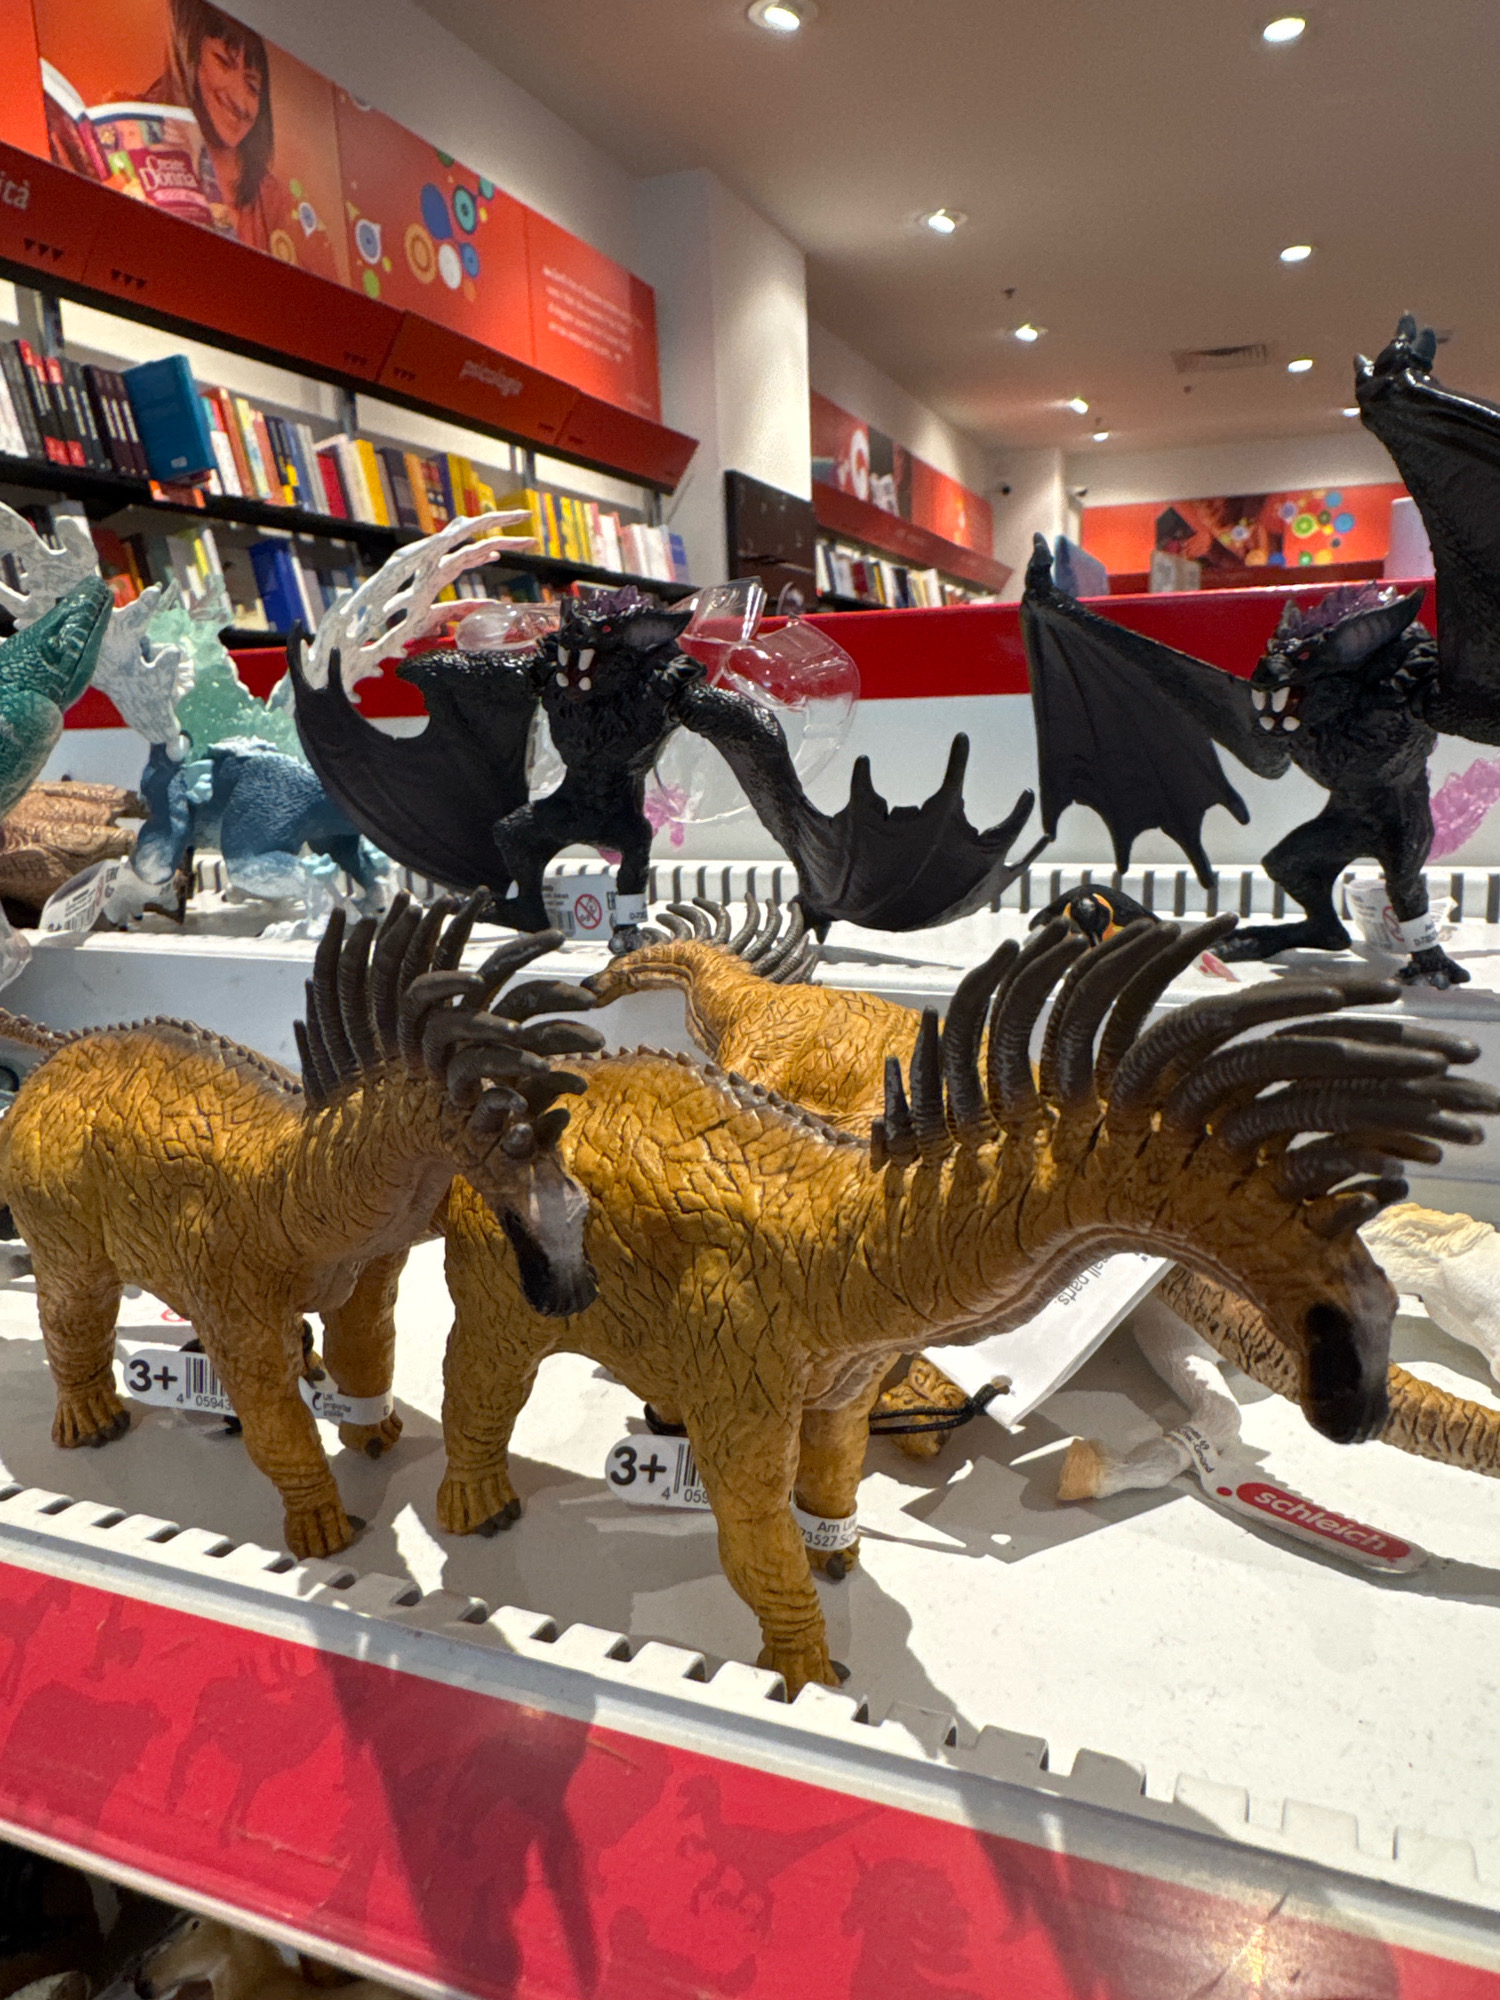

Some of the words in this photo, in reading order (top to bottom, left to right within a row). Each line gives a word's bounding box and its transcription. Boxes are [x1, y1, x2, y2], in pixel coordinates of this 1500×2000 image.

[129, 1359, 178, 1392] 3+
[176, 1393, 185, 1404] 4
[610, 1446, 667, 1485] 3+
[661, 1486, 670, 1500] 4
[817, 1521, 840, 1533] Am
[1254, 1491, 1388, 1551] schleich
